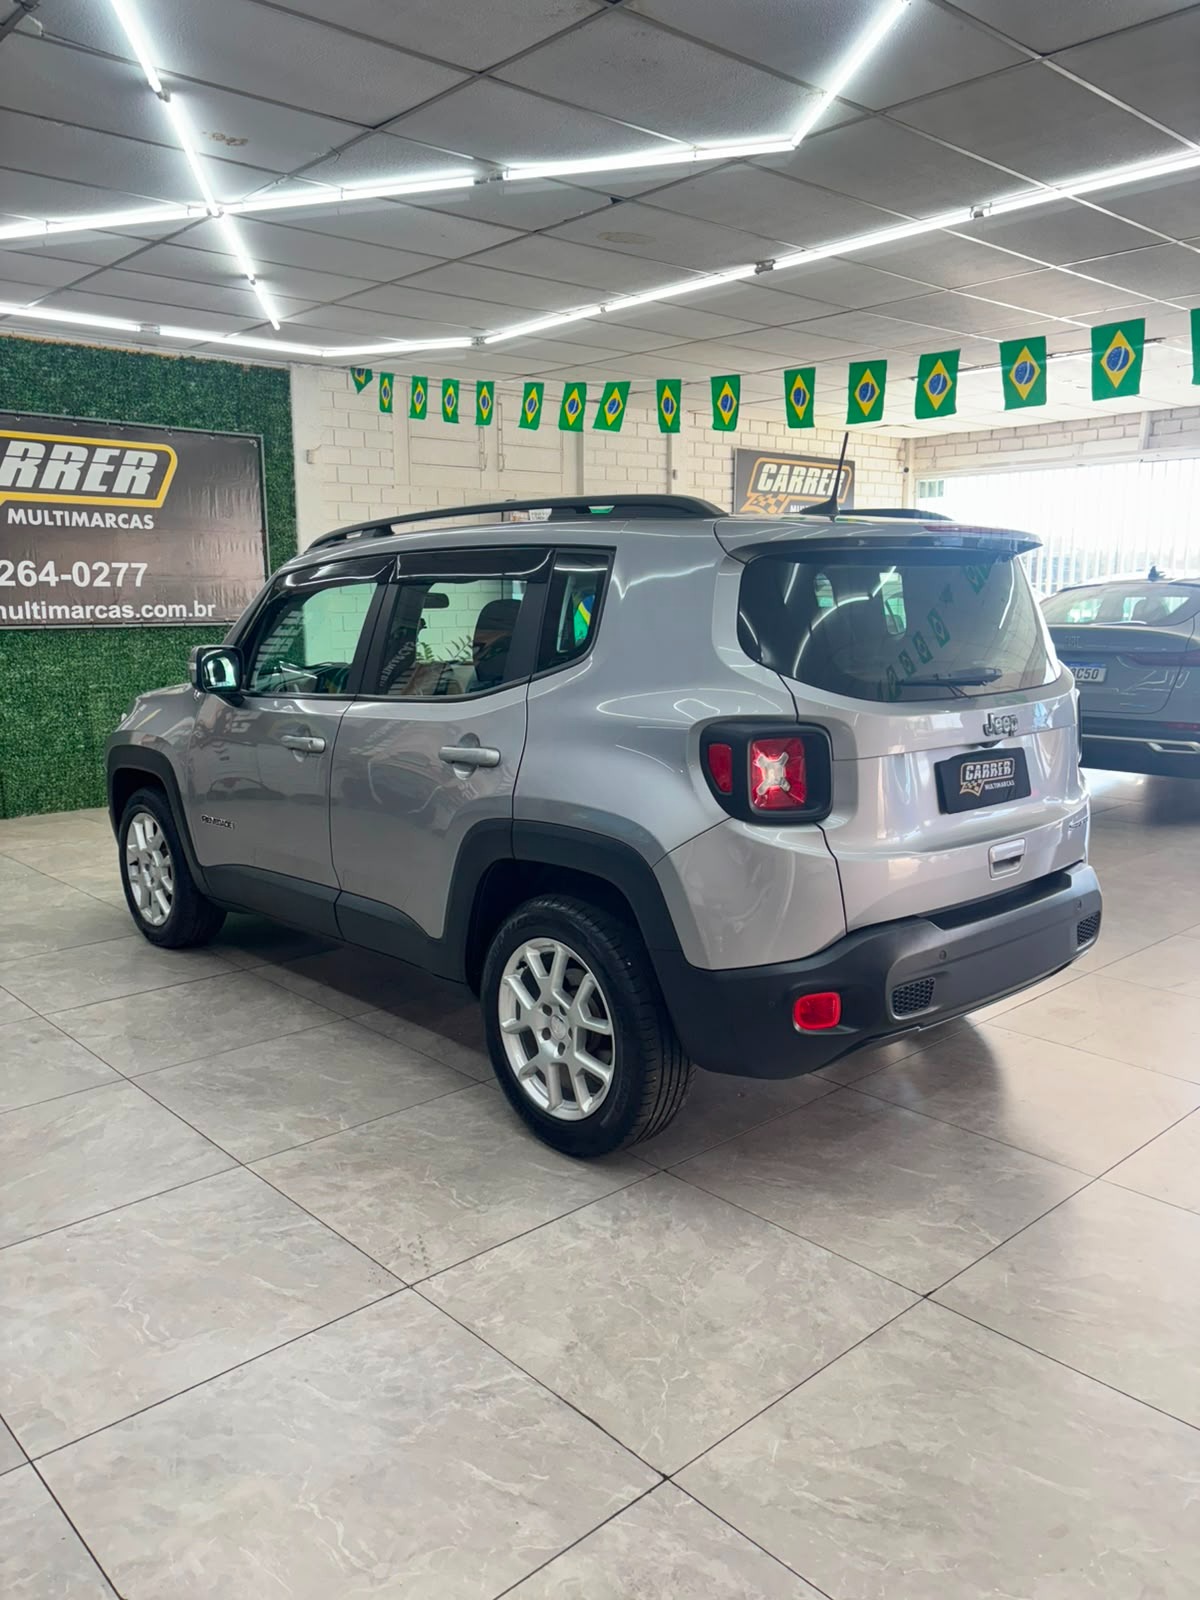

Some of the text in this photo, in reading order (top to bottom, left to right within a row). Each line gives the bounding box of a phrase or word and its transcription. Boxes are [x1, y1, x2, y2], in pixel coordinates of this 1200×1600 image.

[757, 463, 845, 497] CARRER
[7, 508, 154, 530] MULTIMARCAS
[0, 560, 148, 588] 264-0277
[983, 713, 1018, 737] Jeep
[965, 761, 1012, 781] CARRER
